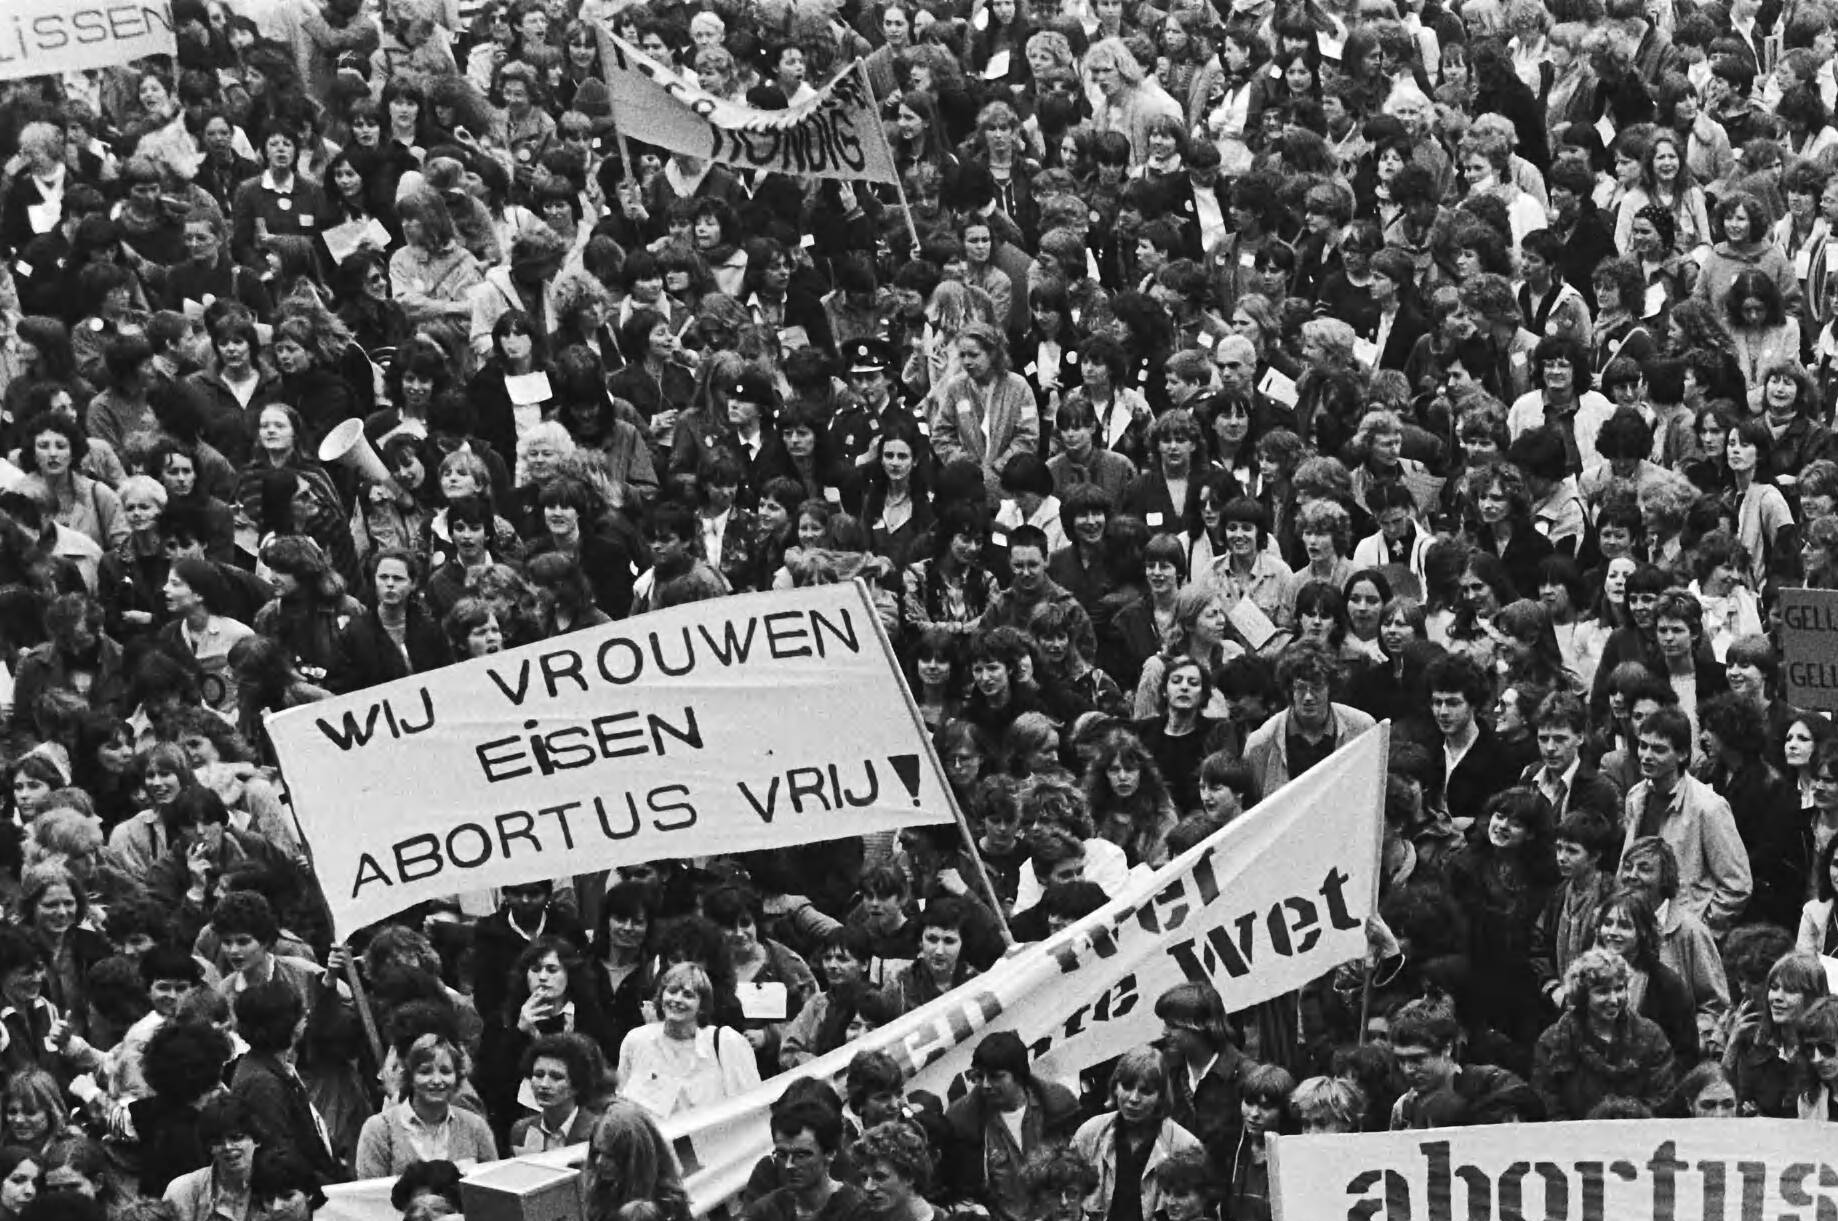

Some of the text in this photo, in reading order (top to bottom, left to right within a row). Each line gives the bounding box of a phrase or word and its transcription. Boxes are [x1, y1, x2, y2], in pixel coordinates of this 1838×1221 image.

[315, 607, 861, 753] WIJ VROUWEN
[350, 753, 922, 899] ABORTUS VRIJ!
